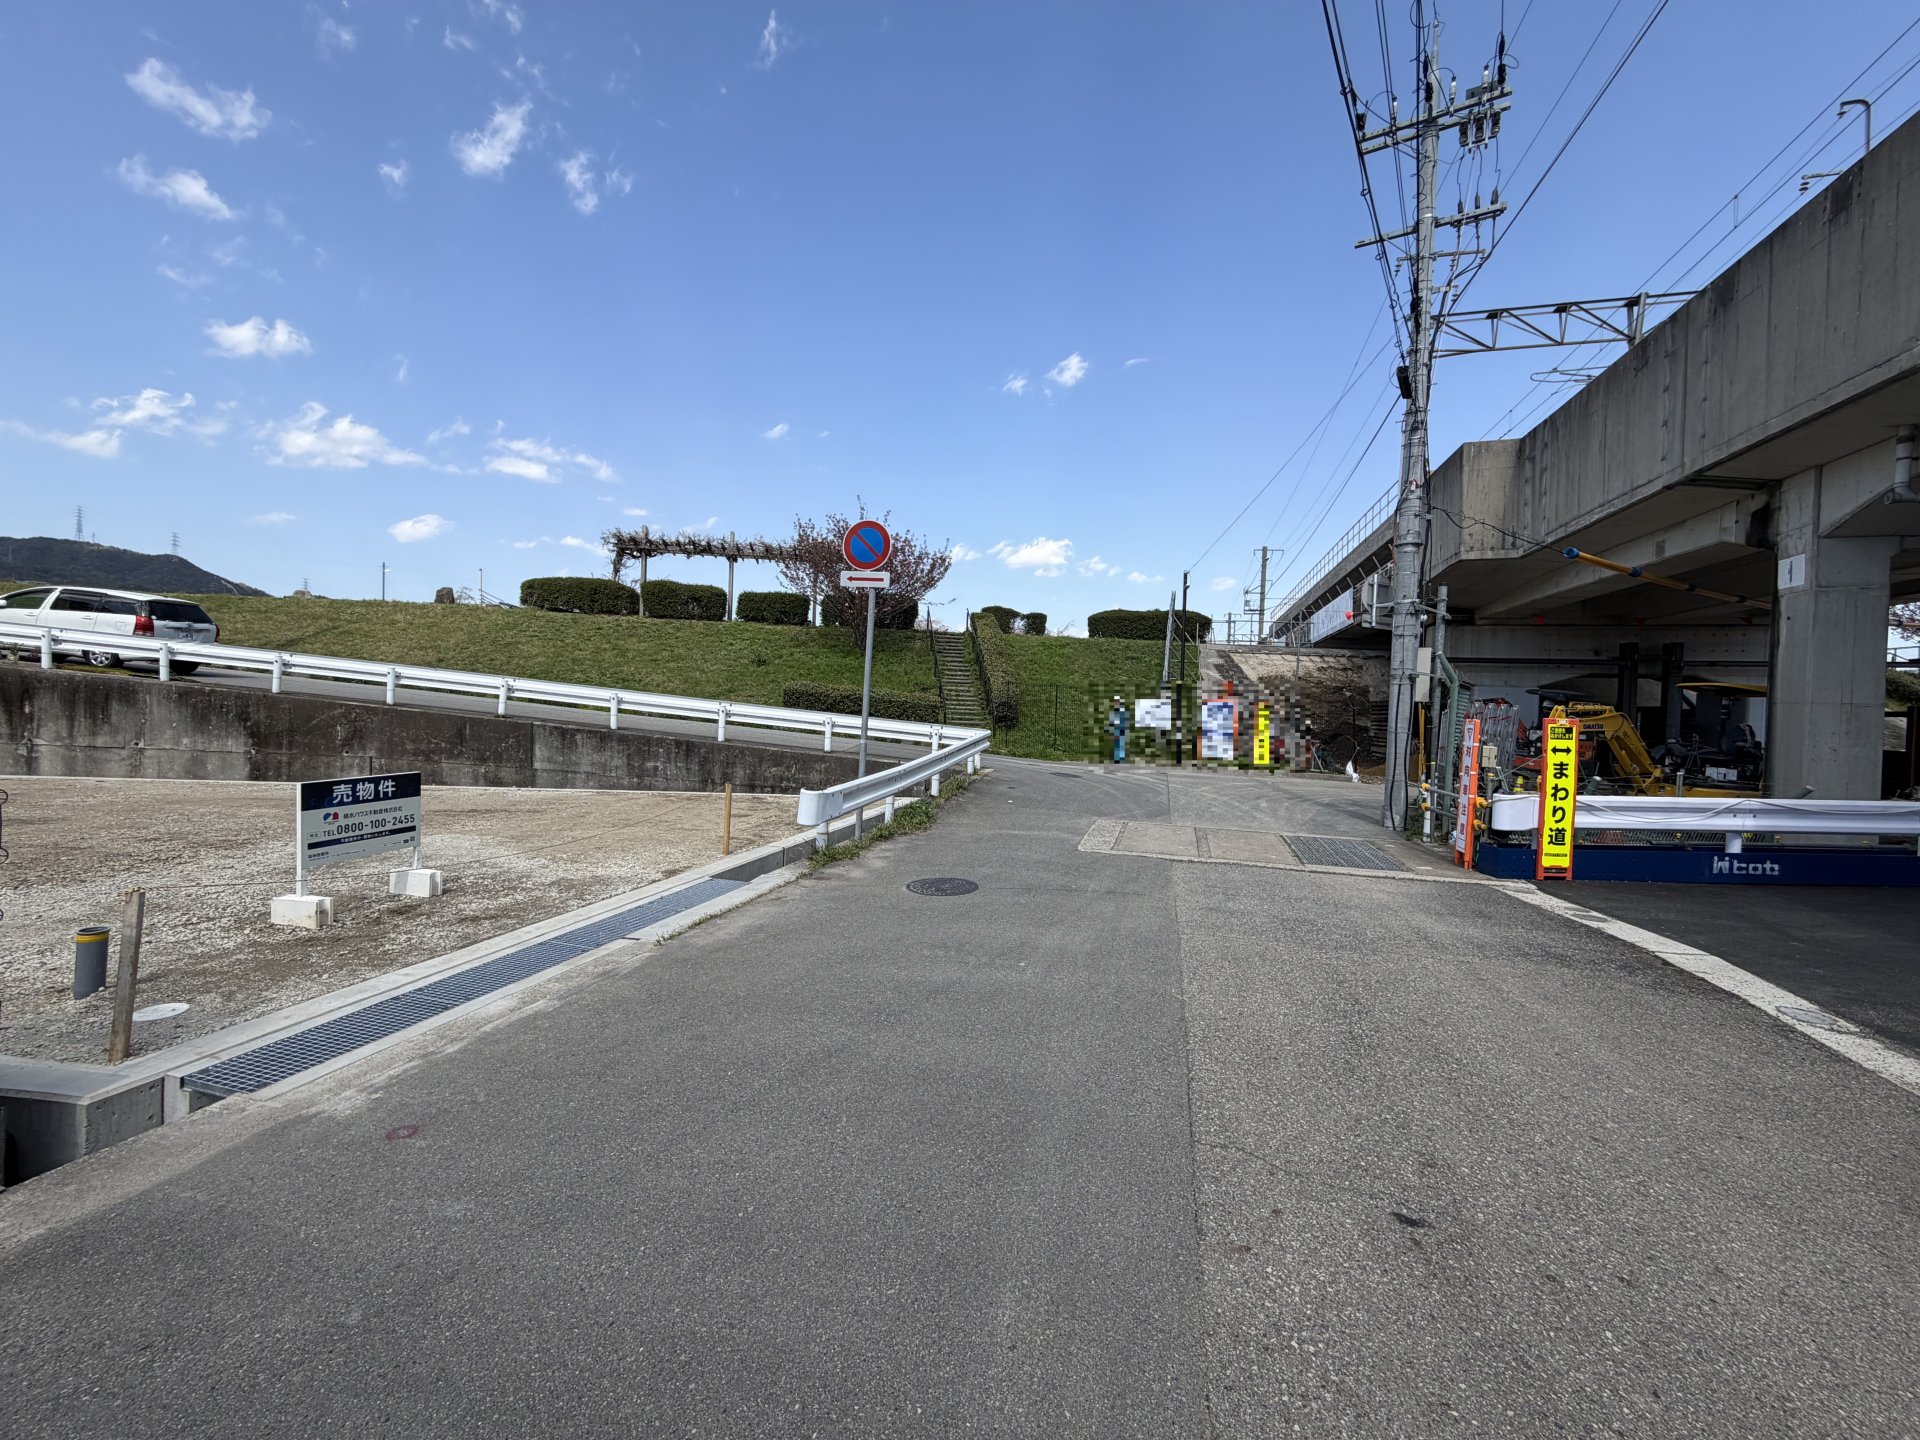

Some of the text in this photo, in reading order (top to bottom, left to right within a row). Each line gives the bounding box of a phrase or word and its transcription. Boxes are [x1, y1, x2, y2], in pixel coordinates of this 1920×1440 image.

[332, 779, 397, 804] 売物件
[1547, 761, 1570, 846] まわり道
[336, 814, 415, 834] 0800-100-2455
